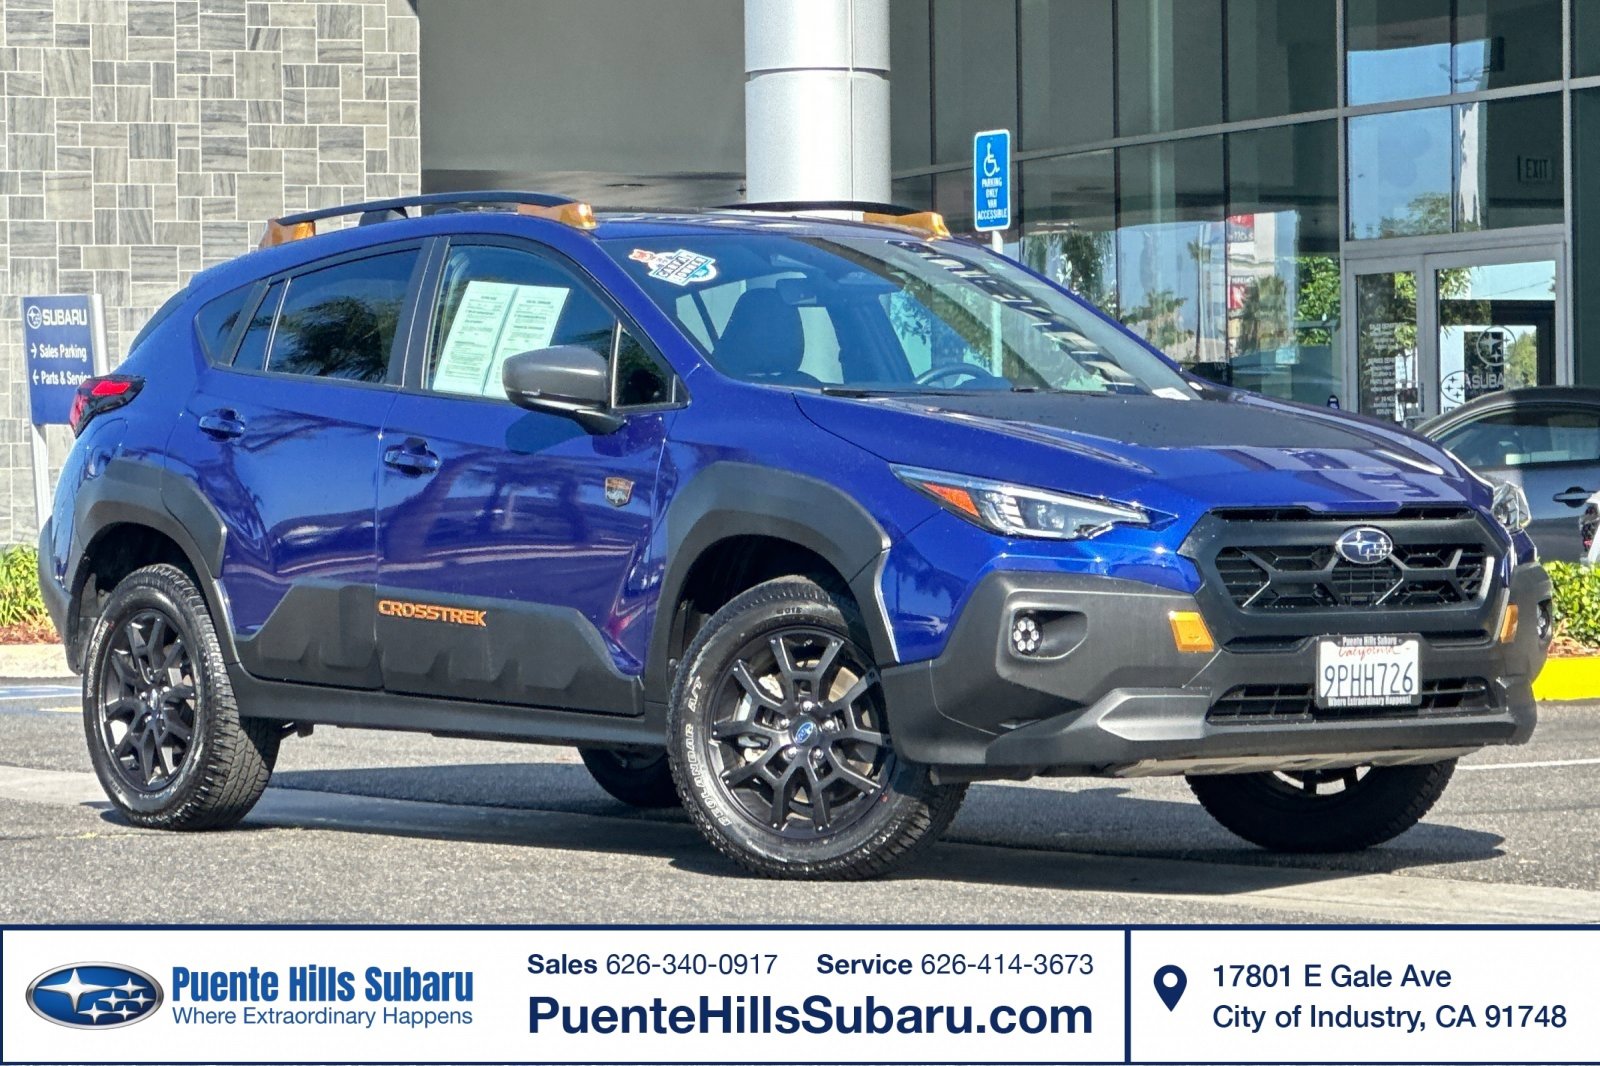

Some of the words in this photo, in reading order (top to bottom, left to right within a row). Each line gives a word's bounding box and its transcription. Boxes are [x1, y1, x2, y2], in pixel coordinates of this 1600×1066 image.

[1526, 158, 1549, 178] EXIT
[981, 178, 1002, 187] PARKING
[986, 188, 998, 198] ONLY
[987, 199, 997, 208] VAN
[978, 208, 1008, 220] ACCESSIBLE
[42, 309, 87, 325] SUBARU
[40, 344, 58, 358] Sales
[60, 344, 87, 362] Parking
[41, 371, 59, 384] Parts
[60, 371, 66, 384] &
[1472, 372, 1525, 389] SUBA
[379, 600, 487, 627] CROSSTREK
[1323, 661, 1413, 697] 9PHH726
